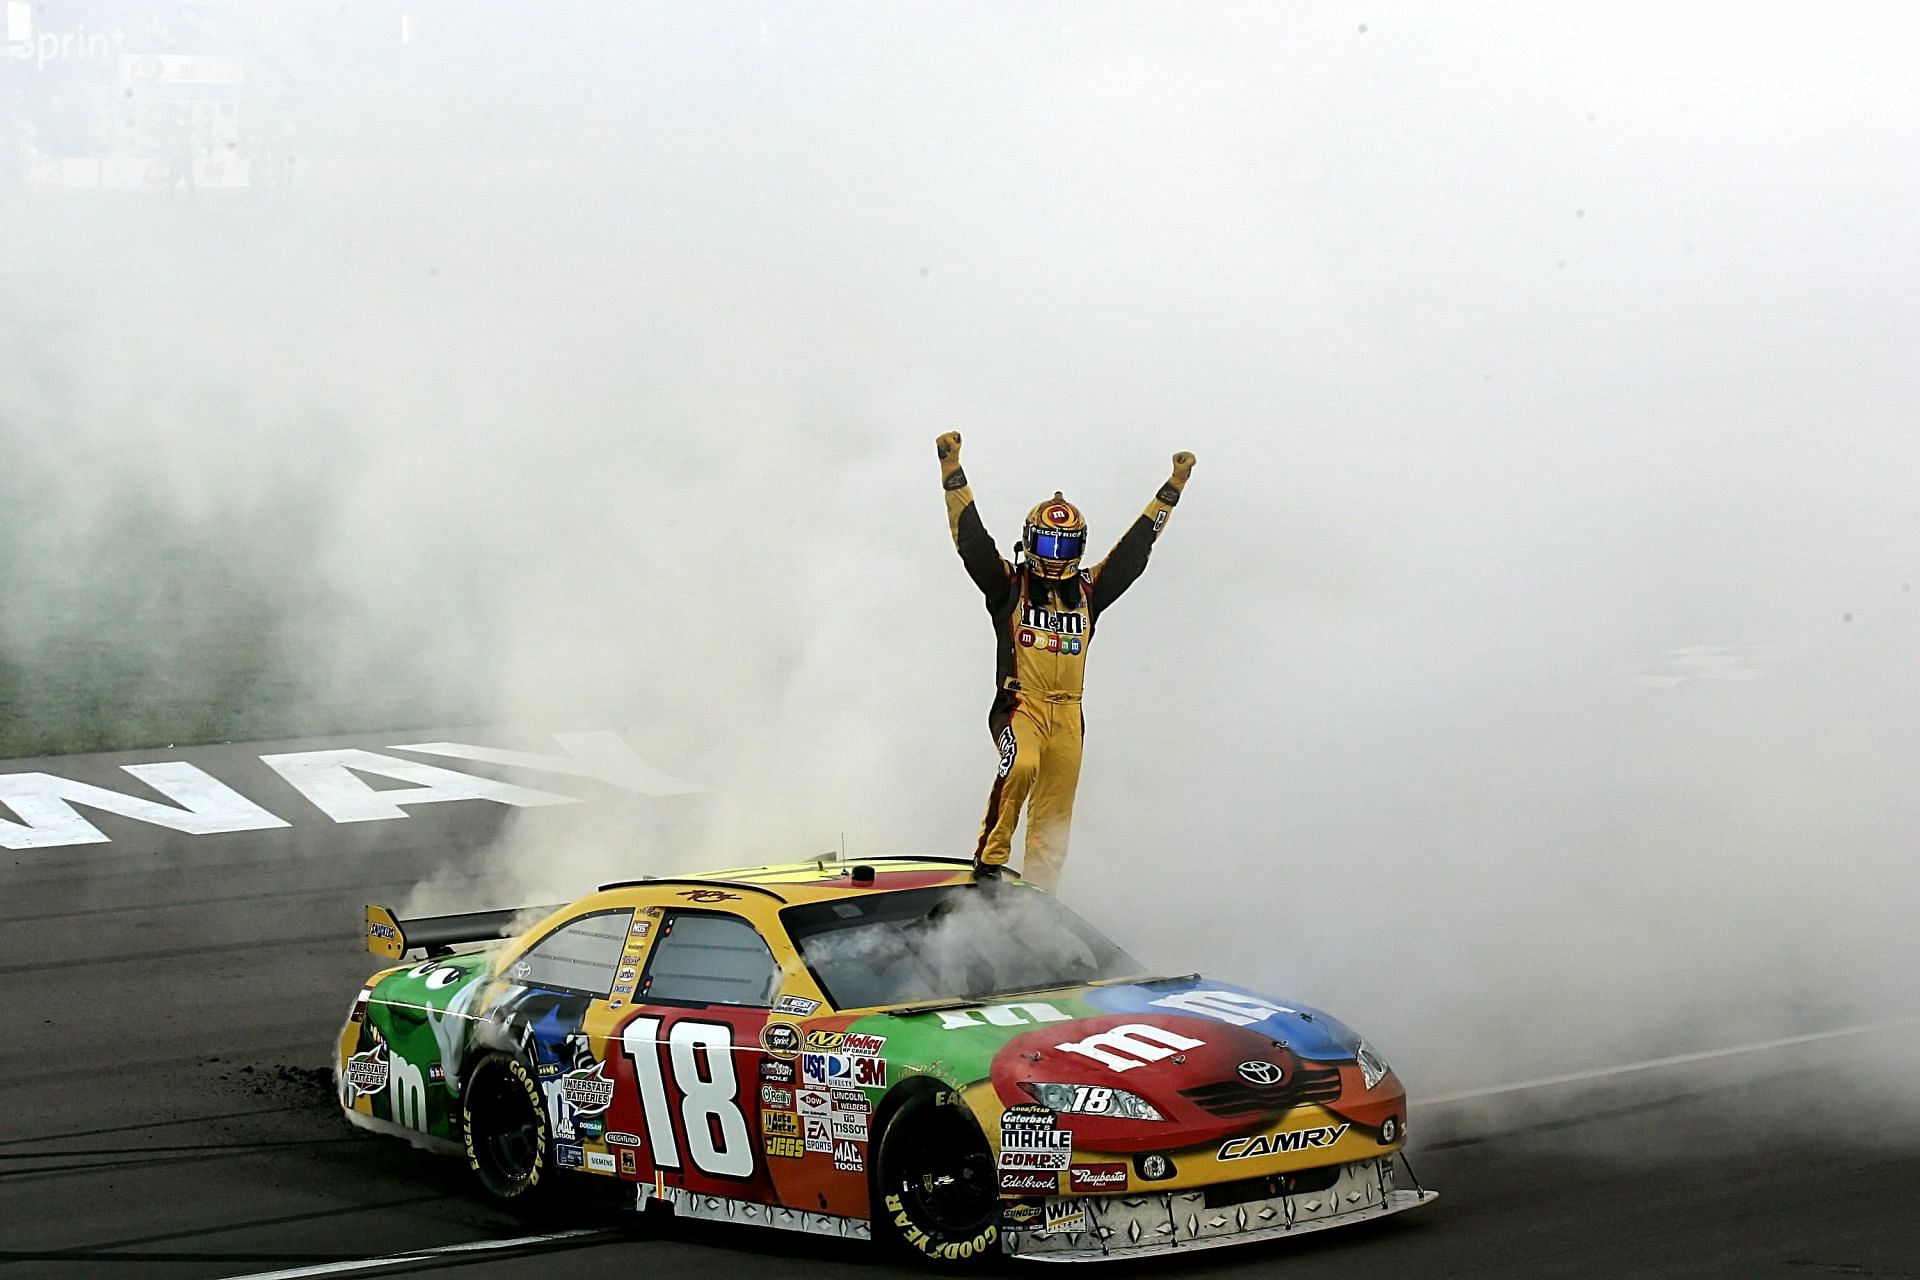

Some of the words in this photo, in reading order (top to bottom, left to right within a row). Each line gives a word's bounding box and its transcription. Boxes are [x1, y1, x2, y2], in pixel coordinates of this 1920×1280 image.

[936, 1003, 1073, 1030] m
[1148, 991, 1297, 1027] m
[772, 1036, 790, 1047] Sprint
[843, 1033, 883, 1055] Holley
[1054, 1024, 1207, 1073] m
[348, 1062, 387, 1075] INTERSTATE
[804, 1054, 826, 1083] USG
[855, 1058, 886, 1086] 3M
[349, 1072, 385, 1085] BATTERIES
[563, 1078, 611, 1094] INTERSTATE
[389, 1050, 428, 1133] m
[566, 1090, 609, 1104] BATTERIES
[623, 1017, 753, 1178] 18
[762, 1086, 791, 1106] O'Reilly
[833, 1091, 863, 1102] LINCOLN
[1070, 1086, 1113, 1113] 18
[805, 1096, 822, 1104] DOW
[840, 1103, 868, 1111] WELDERS
[579, 1121, 602, 1131] DOOSAN
[772, 1113, 791, 1123] Auto
[1002, 1112, 1055, 1124] Gatorback
[556, 1118, 575, 1135] MAC
[771, 1121, 796, 1132] Meter
[807, 1120, 830, 1141] EA
[834, 1122, 866, 1134] TISSOT
[464, 1107, 480, 1170] EAGLE
[557, 1133, 576, 1141] TOOLS
[608, 1134, 638, 1144] FREIGHTLINER
[1001, 1131, 1070, 1148] MAHLE
[1217, 1123, 1351, 1161] CAMRY
[766, 1137, 804, 1157] JEGS
[806, 1140, 832, 1151] SPORTS
[834, 1141, 863, 1162] MAC
[591, 1157, 614, 1167] SIEMENS
[834, 1162, 864, 1172] TOOLS
[1001, 1154, 1052, 1166] COMP
[1001, 1174, 1056, 1189] Edelbrock
[1071, 1169, 1126, 1186] Raybestos
[1004, 1208, 1042, 1218] SUNOCO
[1046, 1199, 1083, 1221] WIX
[885, 1194, 998, 1260] GOODYEAR
